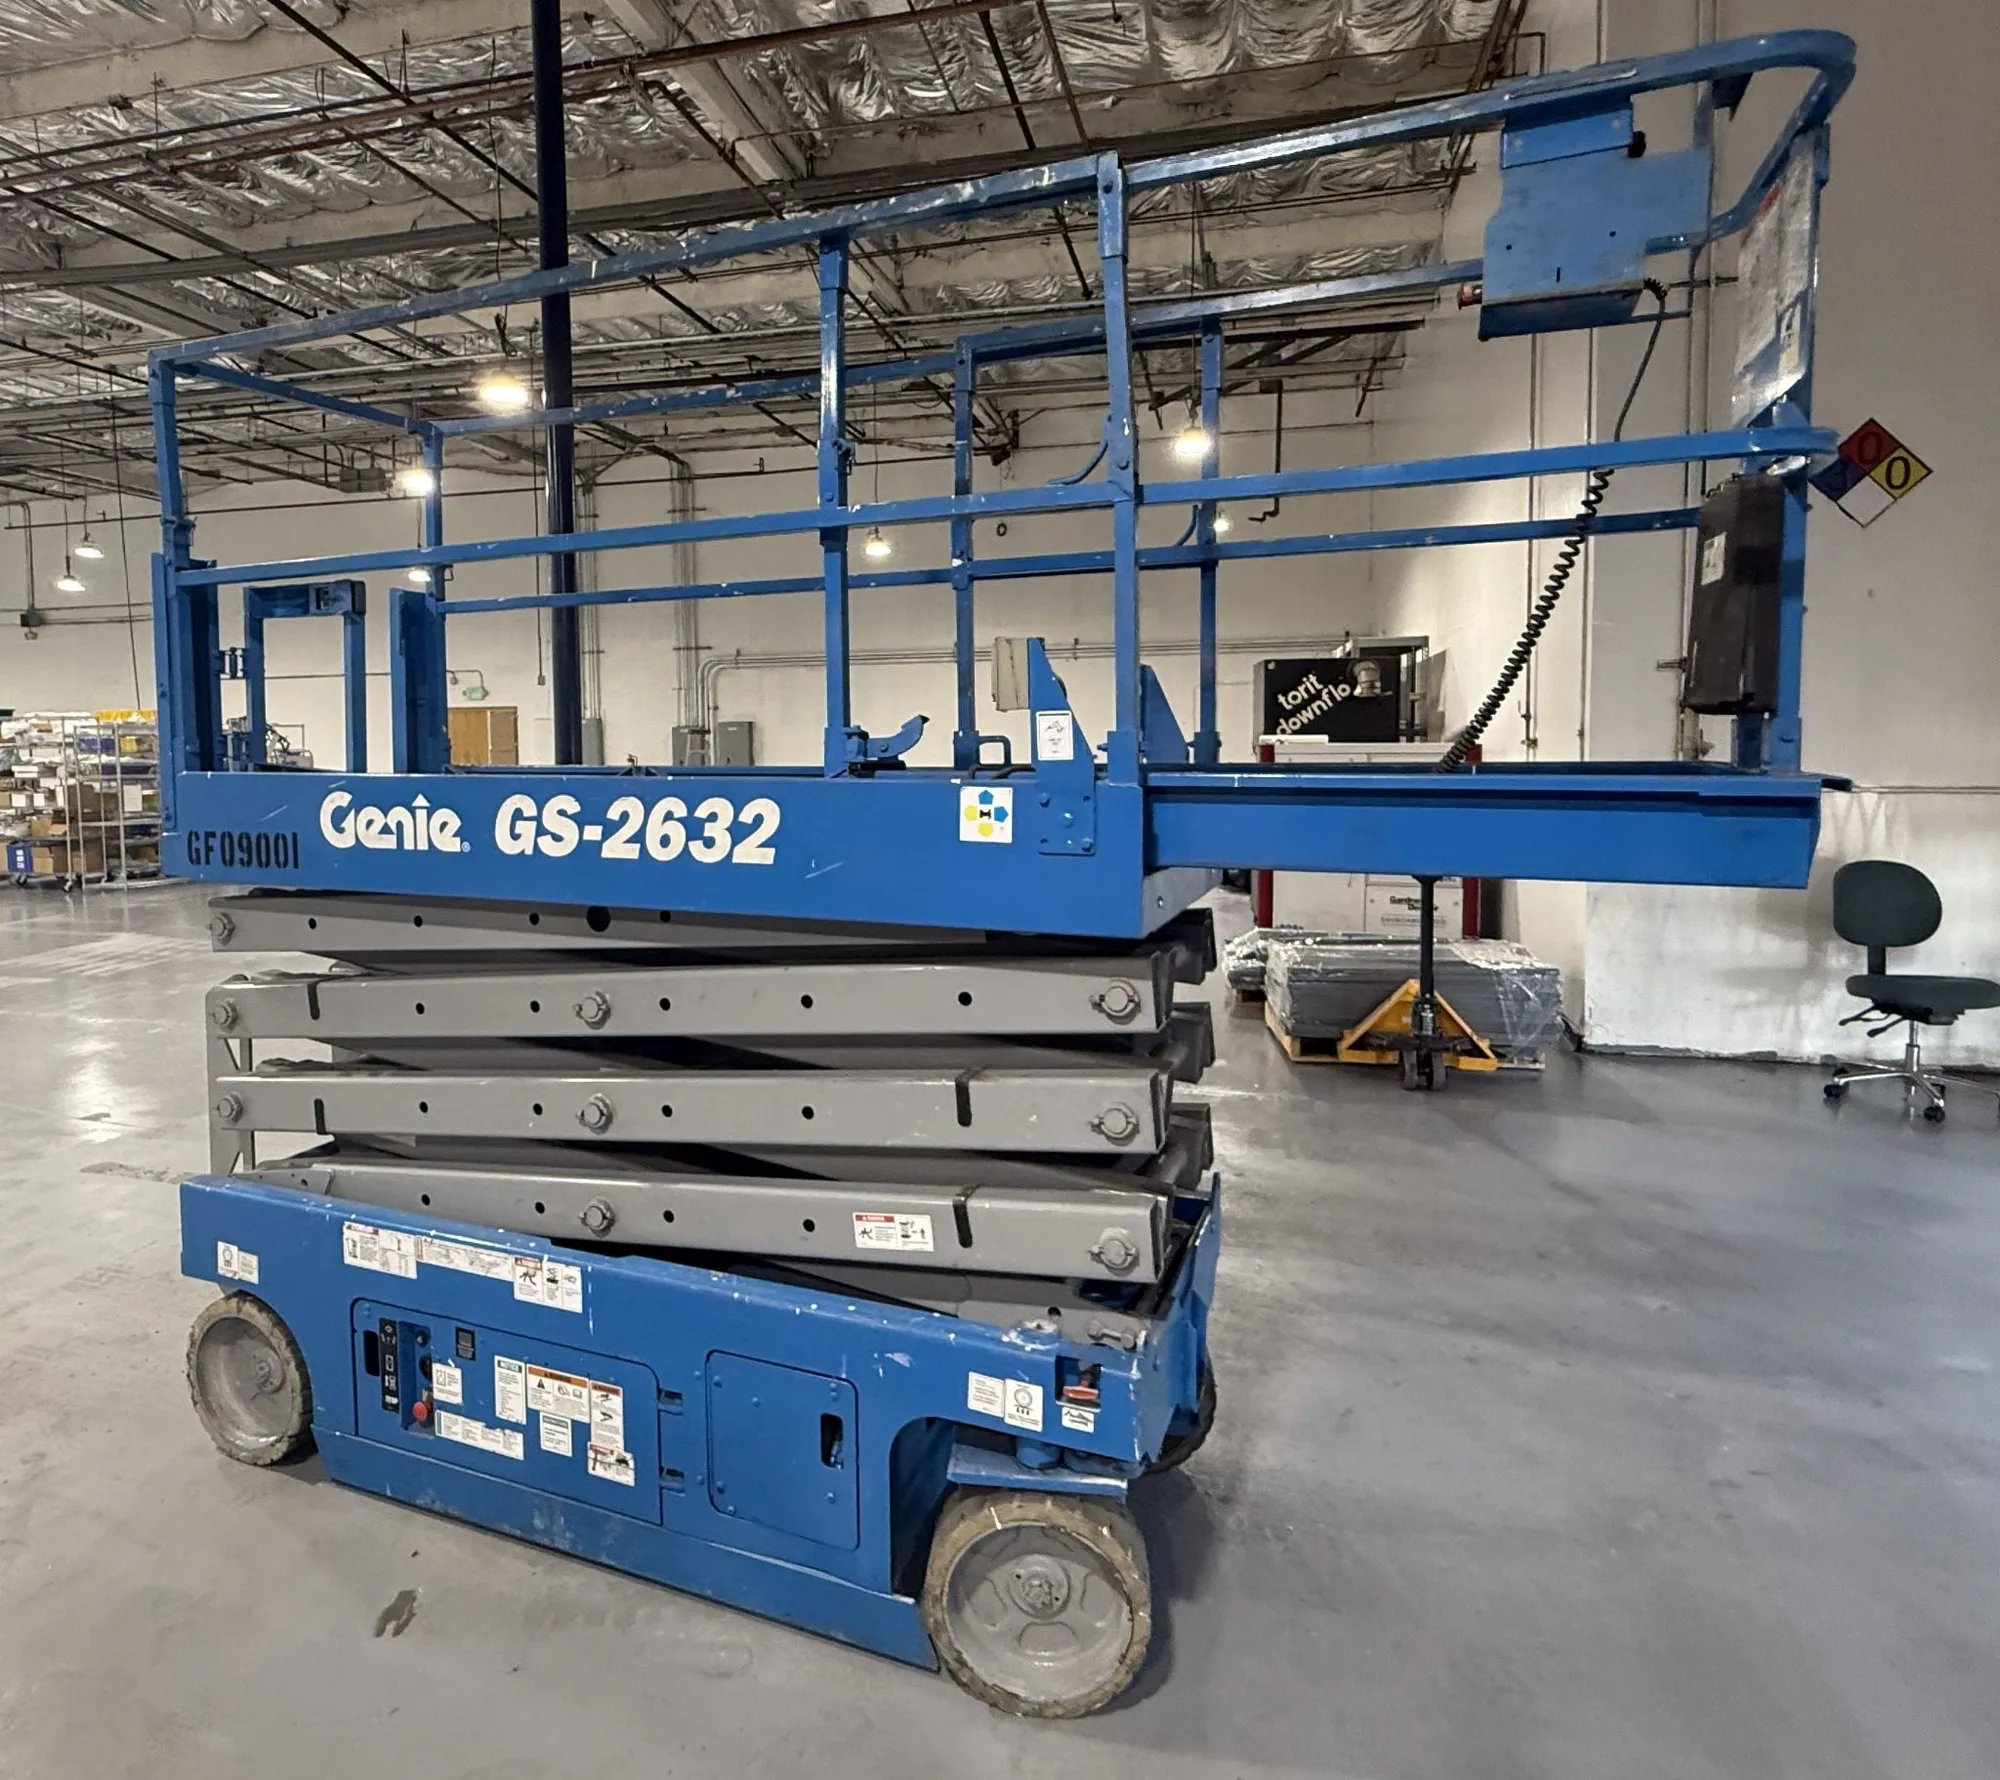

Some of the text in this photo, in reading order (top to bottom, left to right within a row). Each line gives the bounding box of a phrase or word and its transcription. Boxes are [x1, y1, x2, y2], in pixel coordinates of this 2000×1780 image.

[1857, 431, 1882, 466] 0
[1885, 456, 1911, 490] 0
[1276, 683, 1351, 735] downflo
[1277, 673, 1324, 710] torit
[319, 791, 781, 864] Genie GS-2632
[187, 830, 299, 869] GF09001
